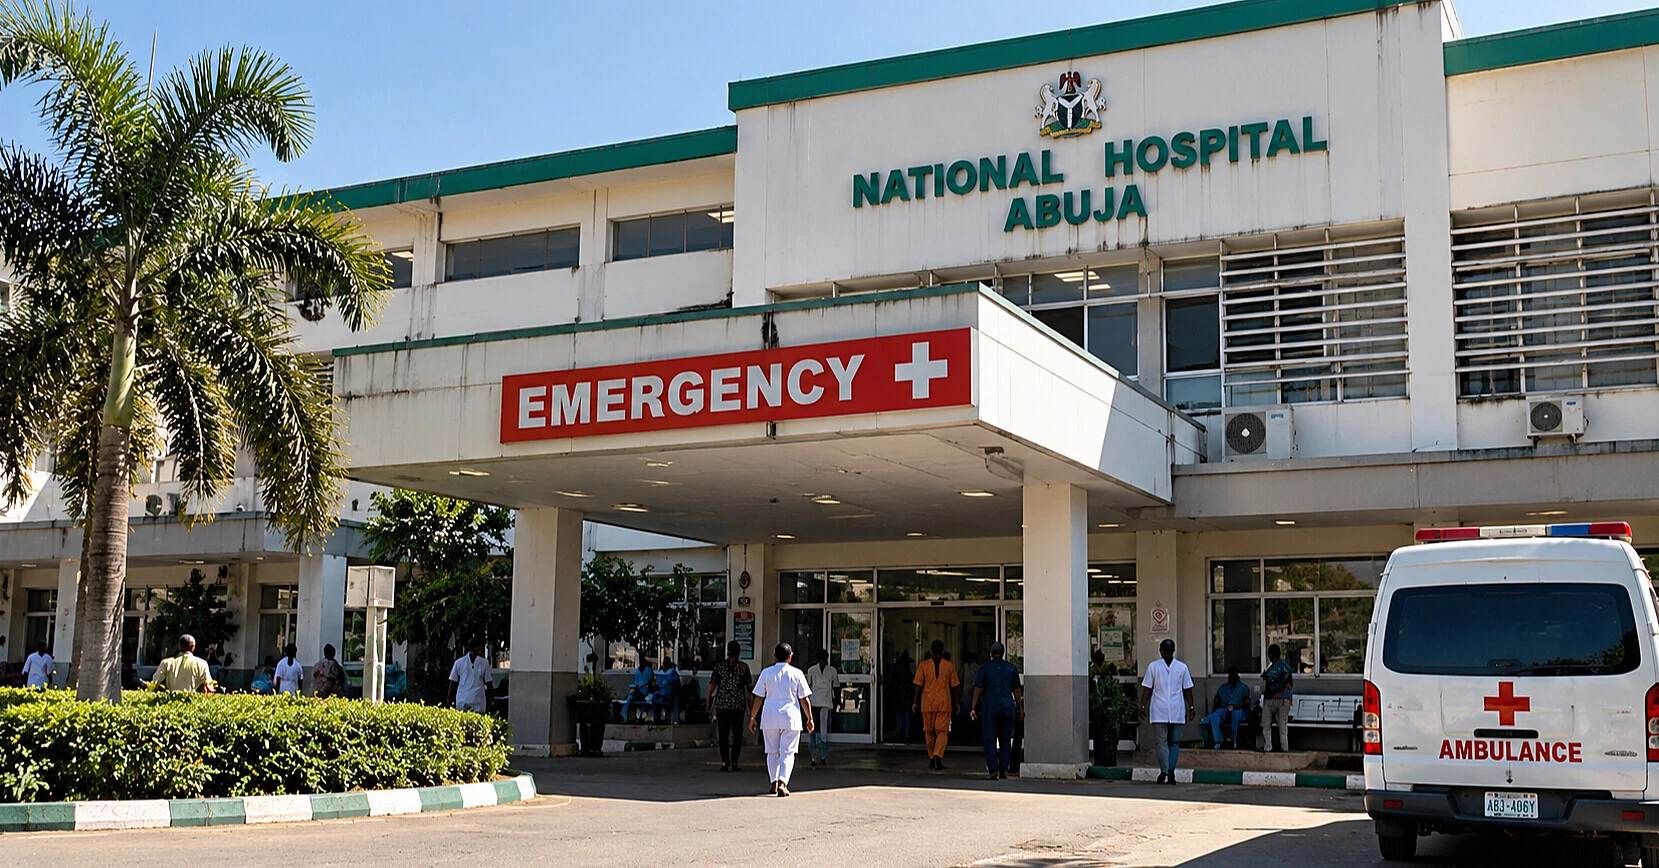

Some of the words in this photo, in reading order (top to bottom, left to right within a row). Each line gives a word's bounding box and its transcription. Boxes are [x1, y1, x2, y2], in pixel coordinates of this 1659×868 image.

[853, 150, 1064, 207] NATIONAL
[1105, 116, 1328, 178] HOSPITAL
[1004, 184, 1148, 232] ABUJA
[518, 354, 865, 429] EMERGENCY
[1439, 739, 1583, 763] AMBULANCE
